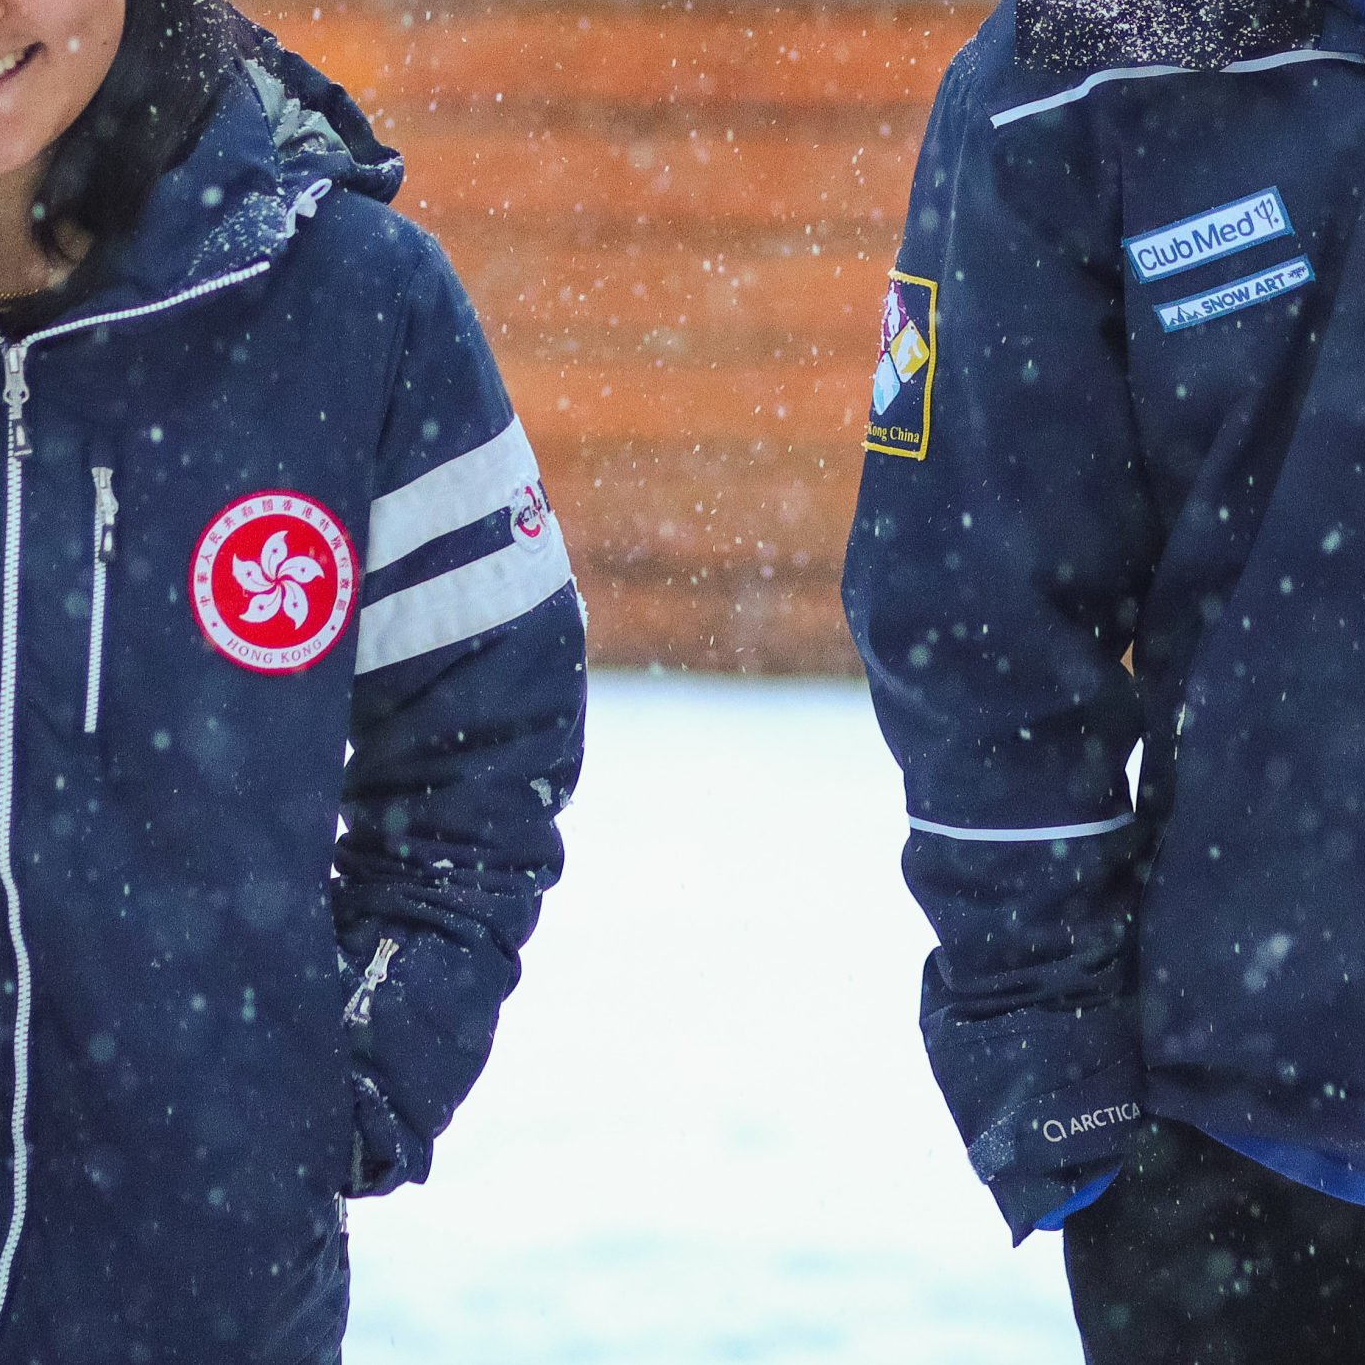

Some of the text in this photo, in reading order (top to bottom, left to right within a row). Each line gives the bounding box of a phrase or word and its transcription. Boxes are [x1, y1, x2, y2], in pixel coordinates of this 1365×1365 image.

[1137, 211, 1255, 271] Club Med
[1201, 273, 1286, 315] SNOW ART
[889, 426, 920, 443] China
[226, 637, 324, 665] HONG KONG
